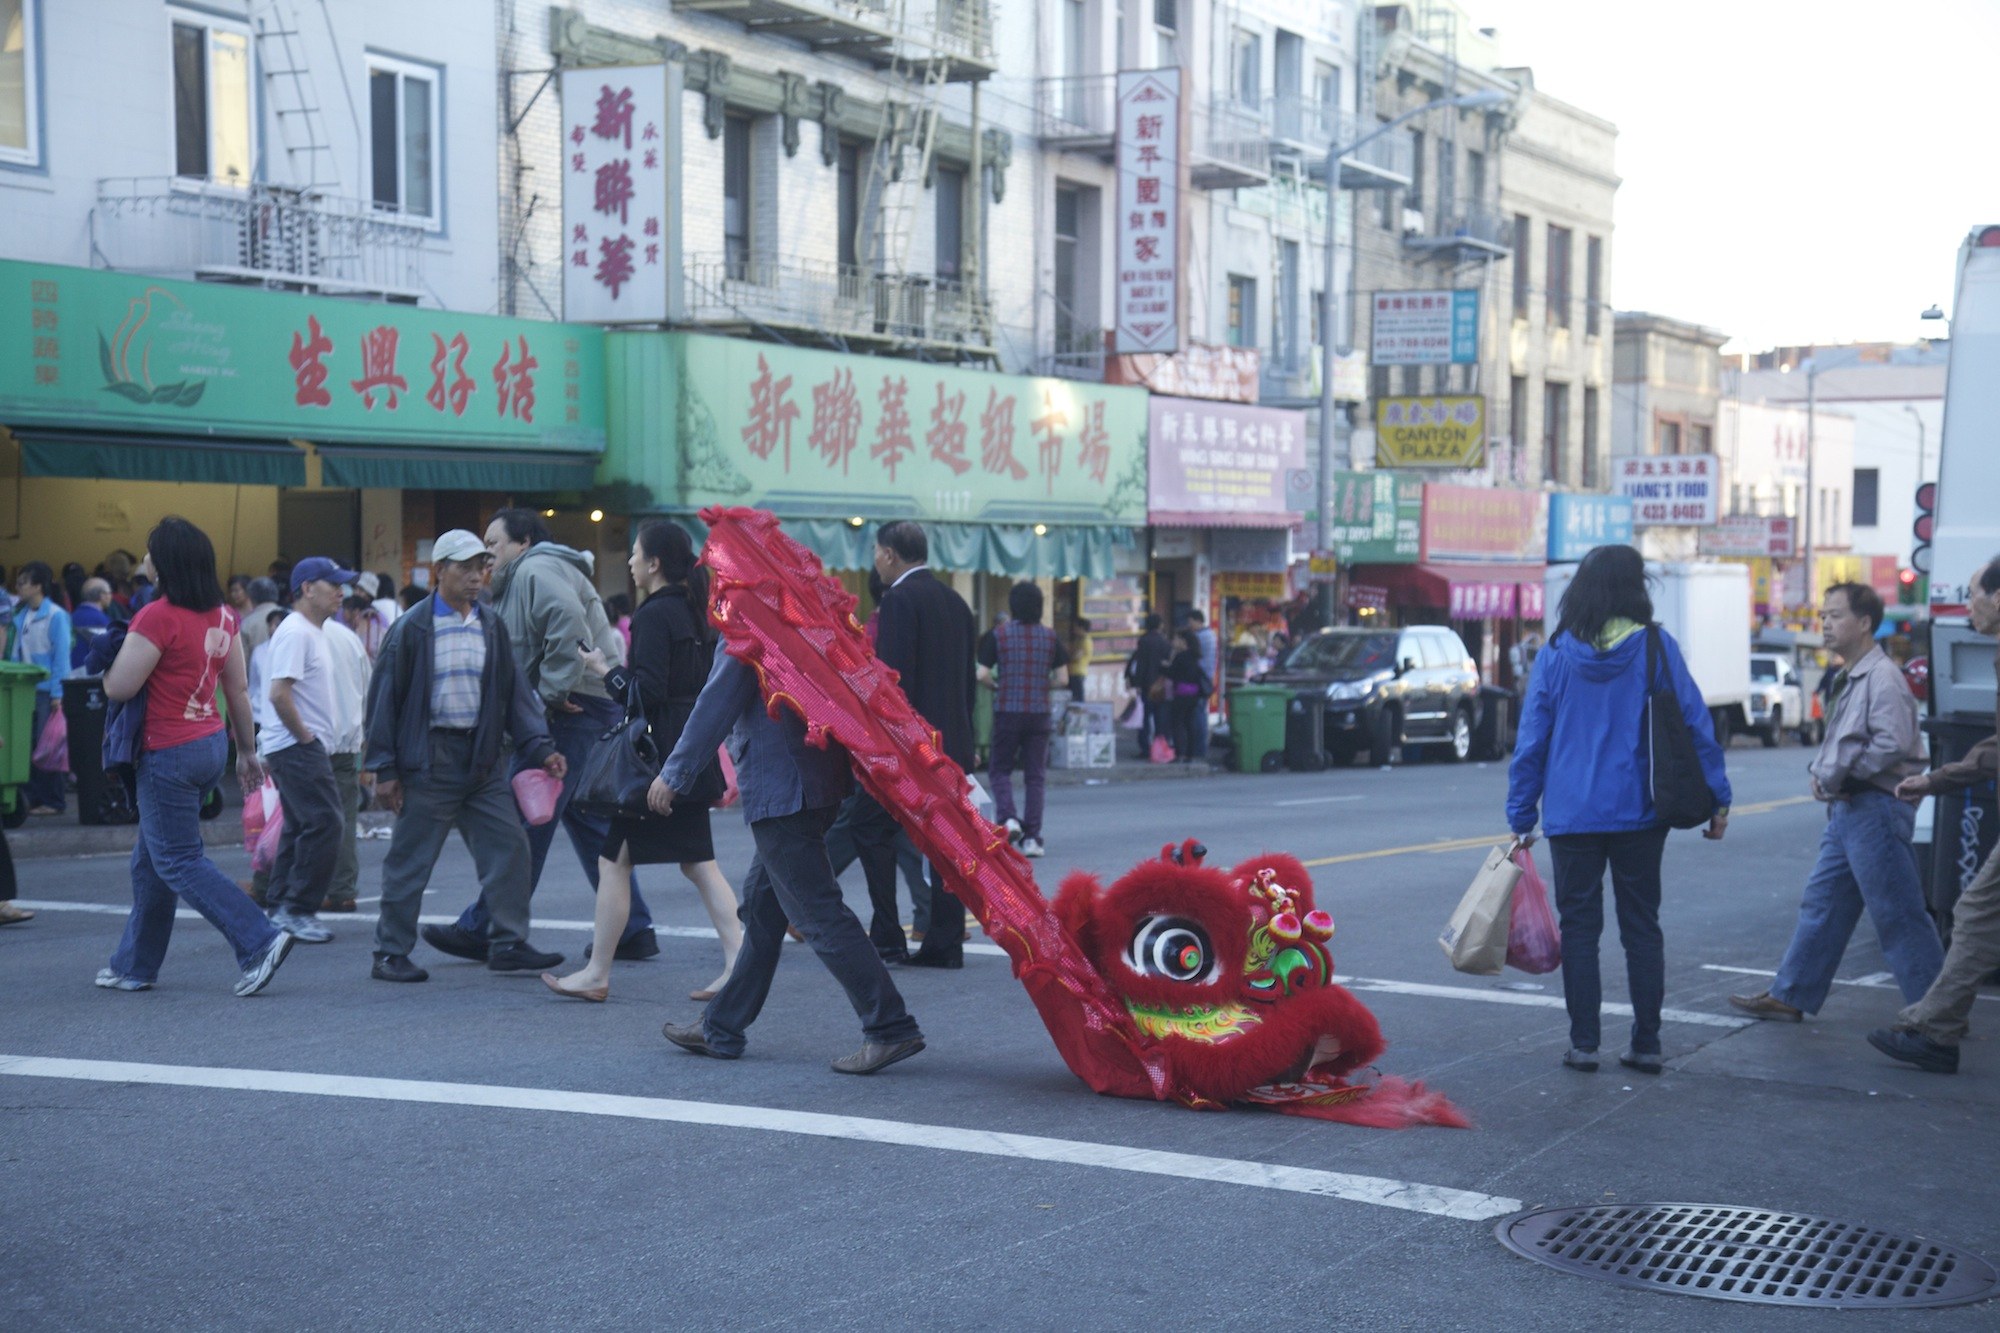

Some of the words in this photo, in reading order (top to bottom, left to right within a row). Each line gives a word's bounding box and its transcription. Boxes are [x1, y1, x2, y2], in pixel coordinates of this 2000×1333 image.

[591, 84, 636, 300] 新聯華
[741, 351, 1112, 495] 新聯華超級市場
[1395, 428, 1467, 442] CANTON
[1401, 443, 1462, 458] PLAZA
[1677, 482, 1708, 498] FOOD
